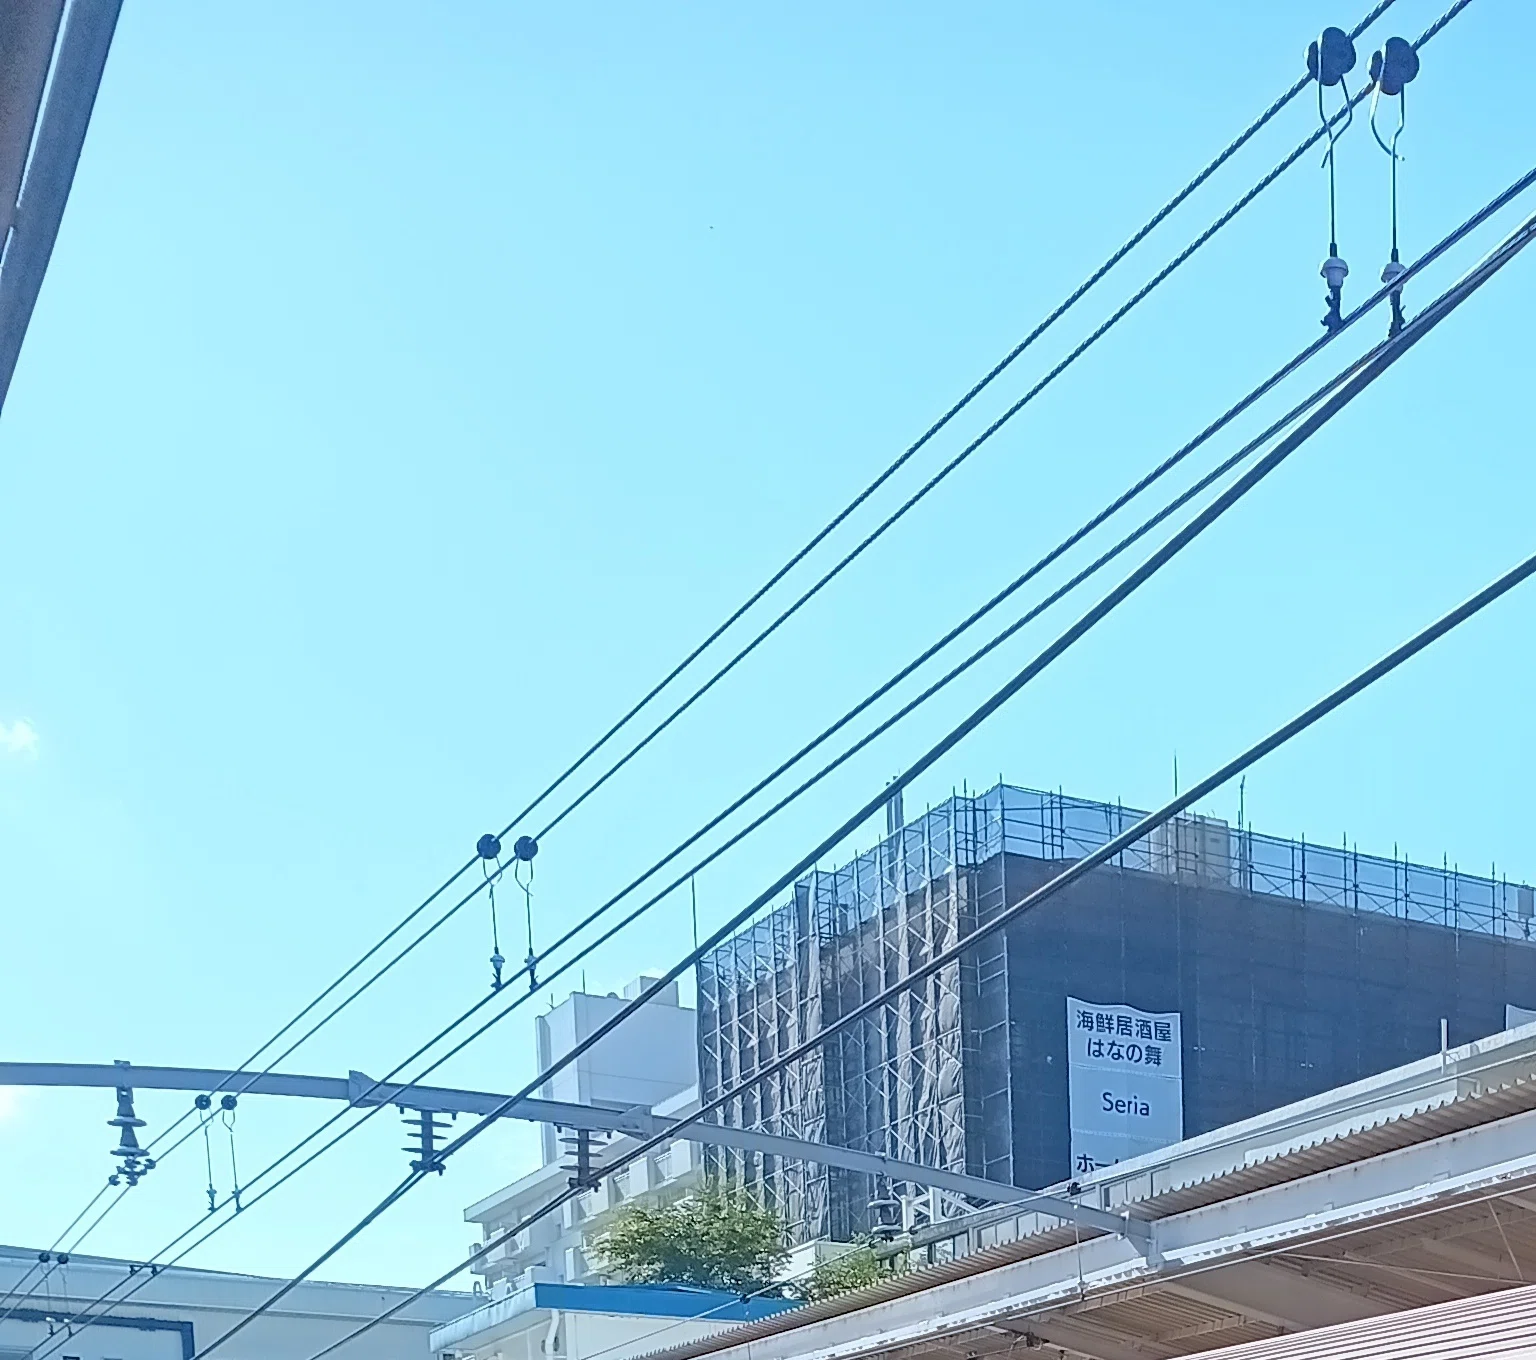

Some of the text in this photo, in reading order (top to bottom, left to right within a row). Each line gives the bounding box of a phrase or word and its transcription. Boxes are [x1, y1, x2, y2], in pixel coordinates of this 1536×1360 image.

[1076, 1009, 1172, 1042] 海鮮居酒屋
[1087, 1038, 1162, 1067] はなの舞
[1102, 1092, 1150, 1116] Seria
[1076, 1153, 1119, 1173] ホー
